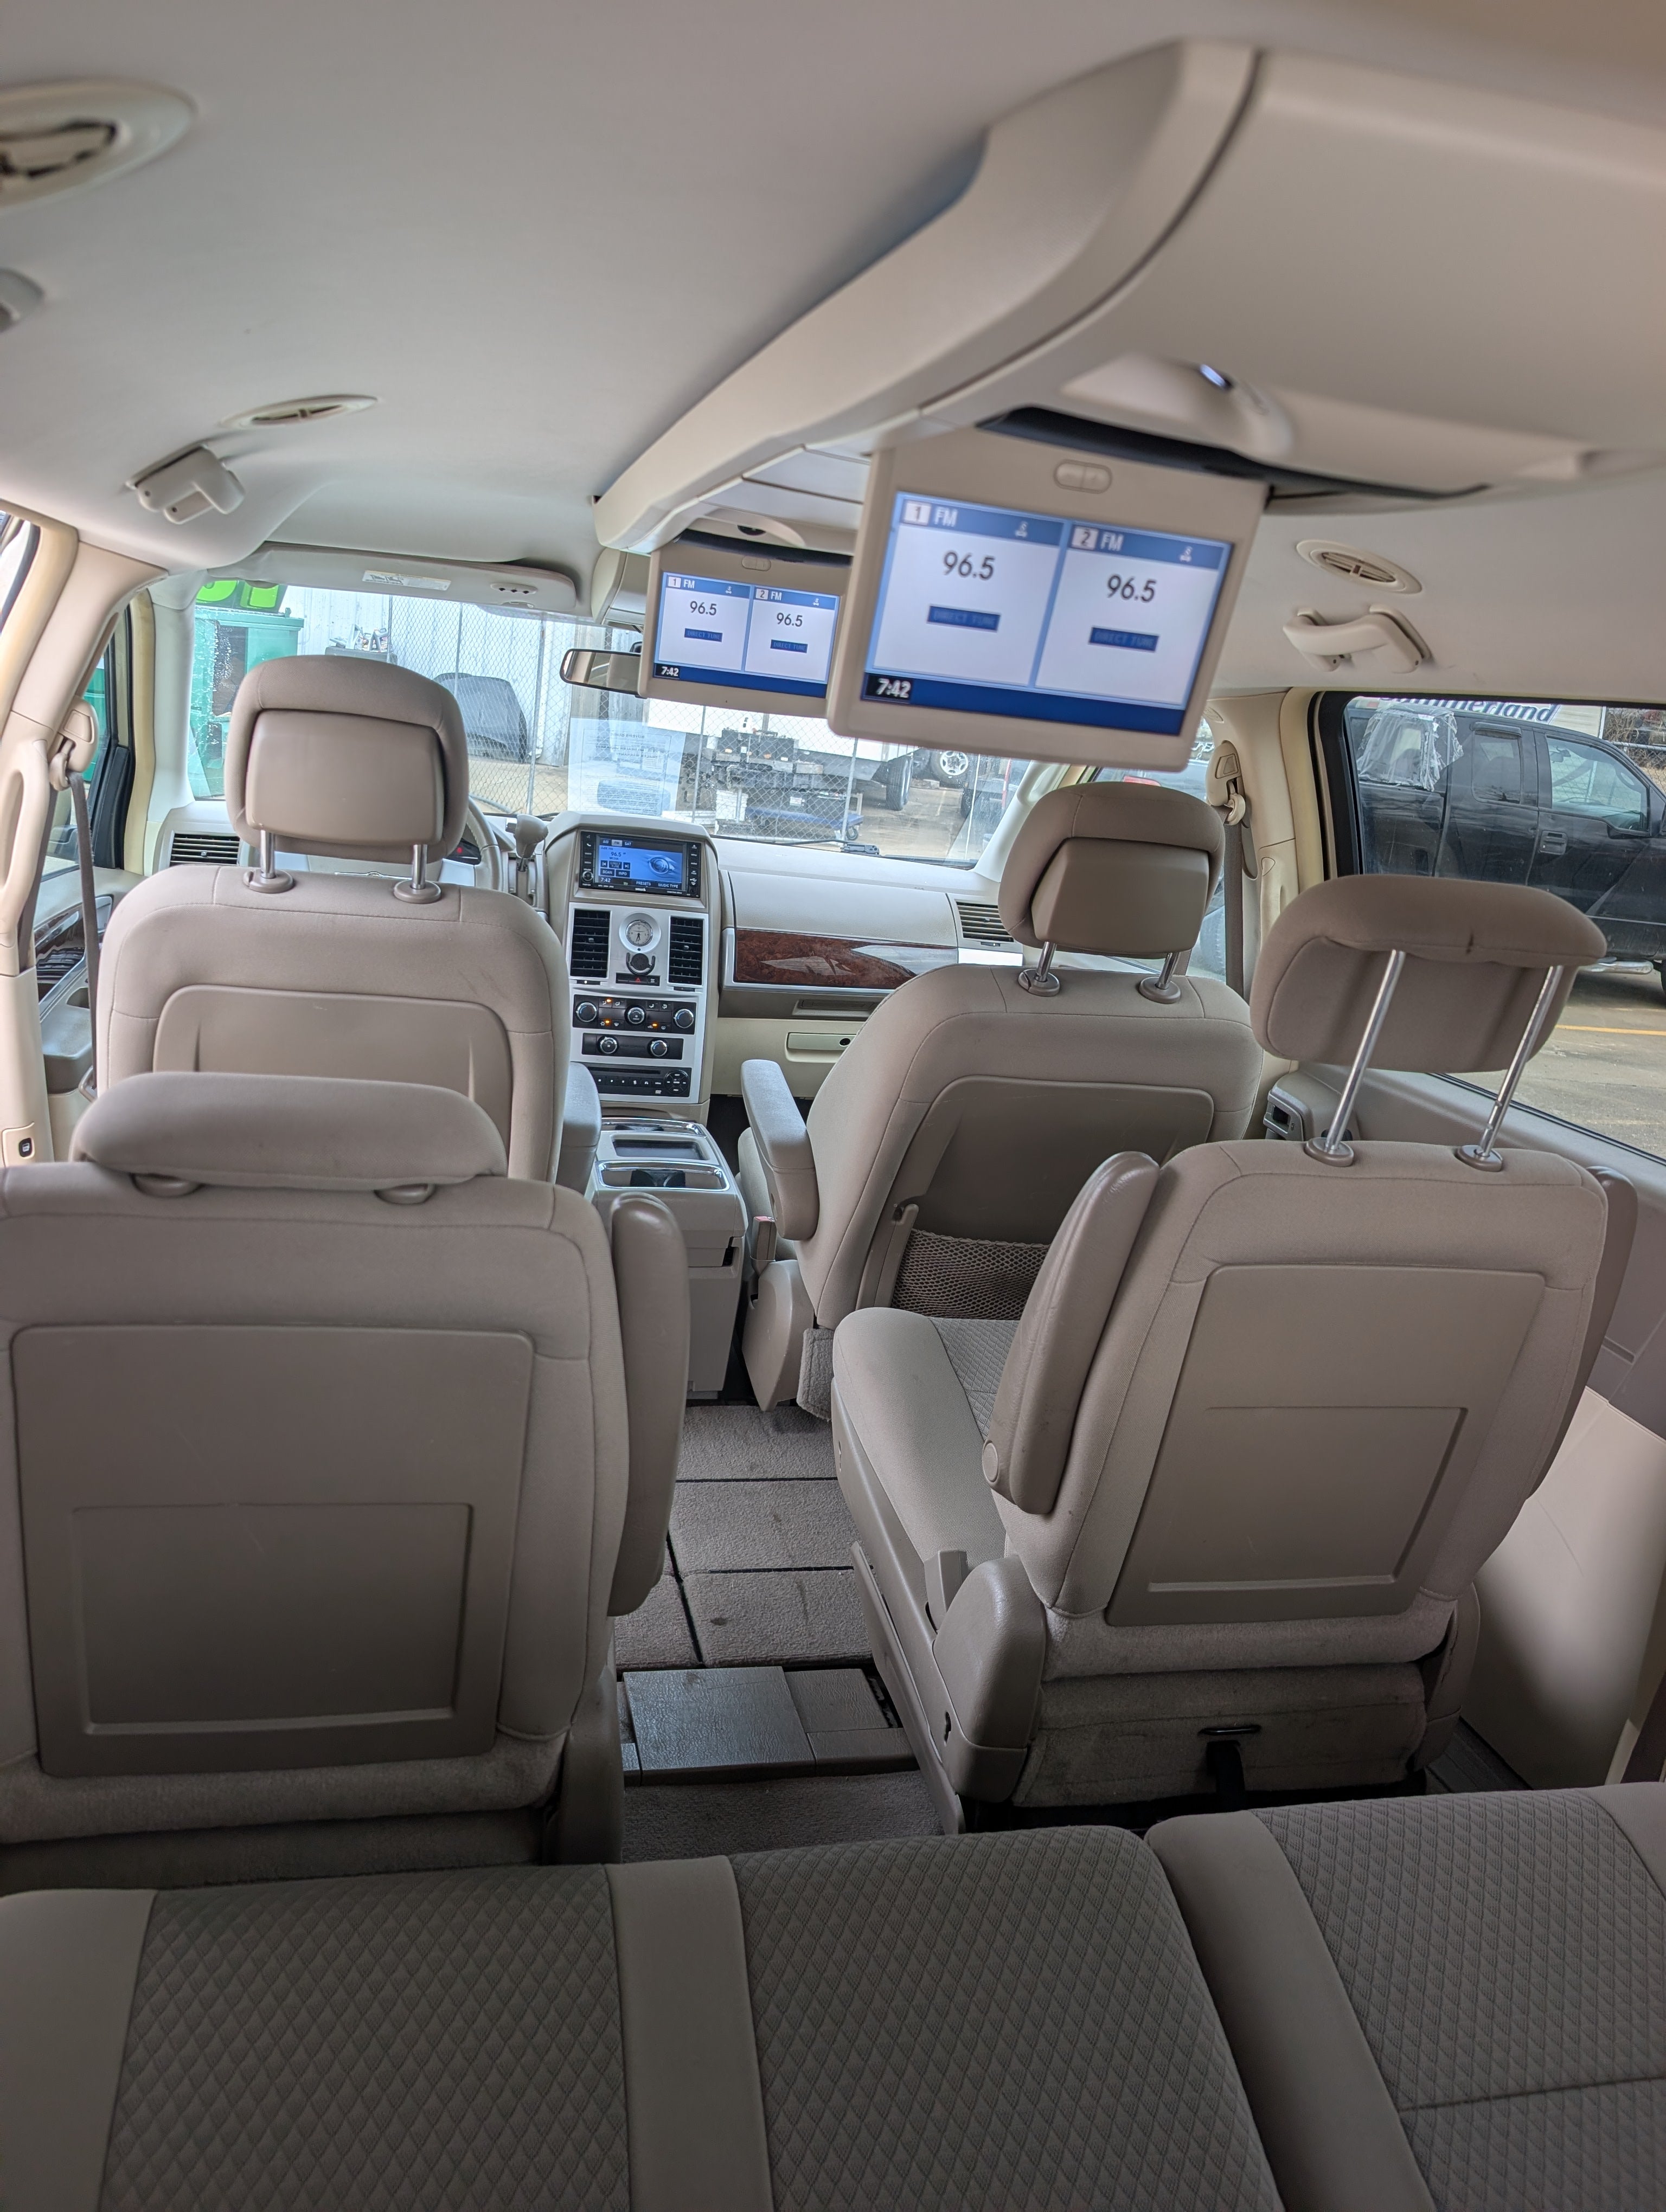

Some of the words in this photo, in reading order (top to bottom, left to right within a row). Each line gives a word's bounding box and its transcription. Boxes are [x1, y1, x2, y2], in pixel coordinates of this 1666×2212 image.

[934, 506, 958, 528] FM
[1081, 529, 1091, 546] 2
[1100, 532, 1124, 551] FM
[943, 550, 996, 581] 96.5
[683, 579, 695, 589] FM
[1106, 574, 1157, 603] 96.5
[771, 591, 782, 601] FM
[690, 601, 717, 616] 96.5
[777, 612, 803, 627] 96.5
[687, 630, 705, 638] DIRECT
[661, 666, 679, 677] 7:42
[876, 678, 911, 698] 7:42
[1381, 698, 1562, 724] merland
